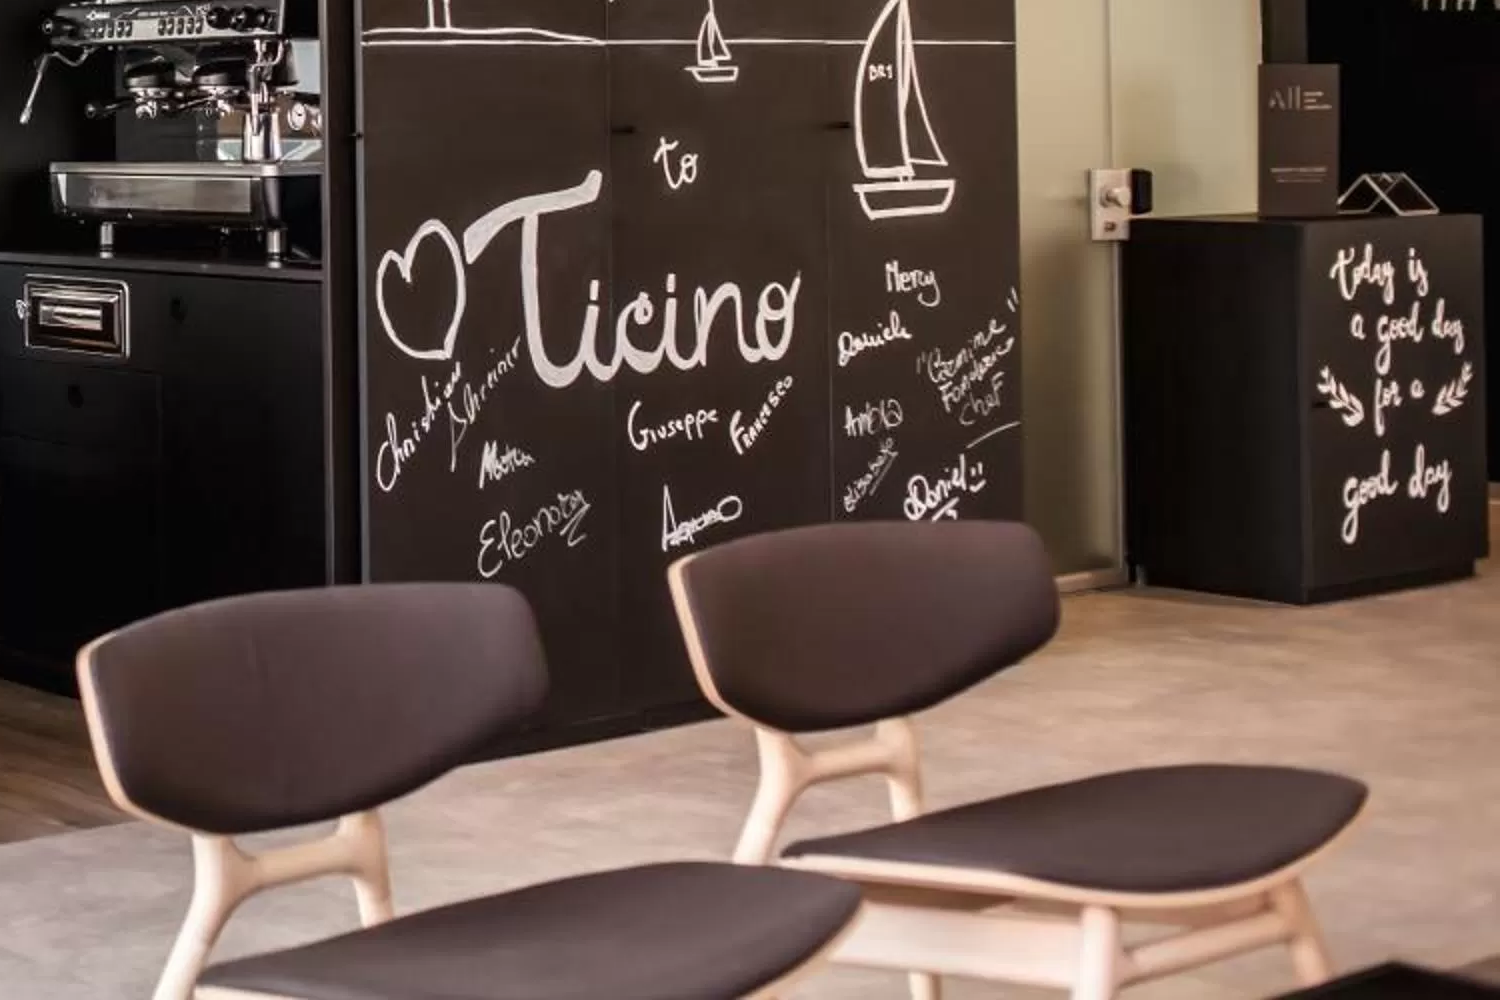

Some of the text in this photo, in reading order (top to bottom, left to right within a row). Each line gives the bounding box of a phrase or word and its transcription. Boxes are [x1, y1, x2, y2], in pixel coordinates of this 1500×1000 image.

[653, 136, 699, 189] to
[463, 169, 801, 388] Ticino
[1407, 247, 1429, 297] is
[1350, 297, 1465, 376] a good day
[627, 400, 720, 451] Giuseppe
[1374, 377, 1426, 437] for a
[1341, 443, 1453, 545] good day
